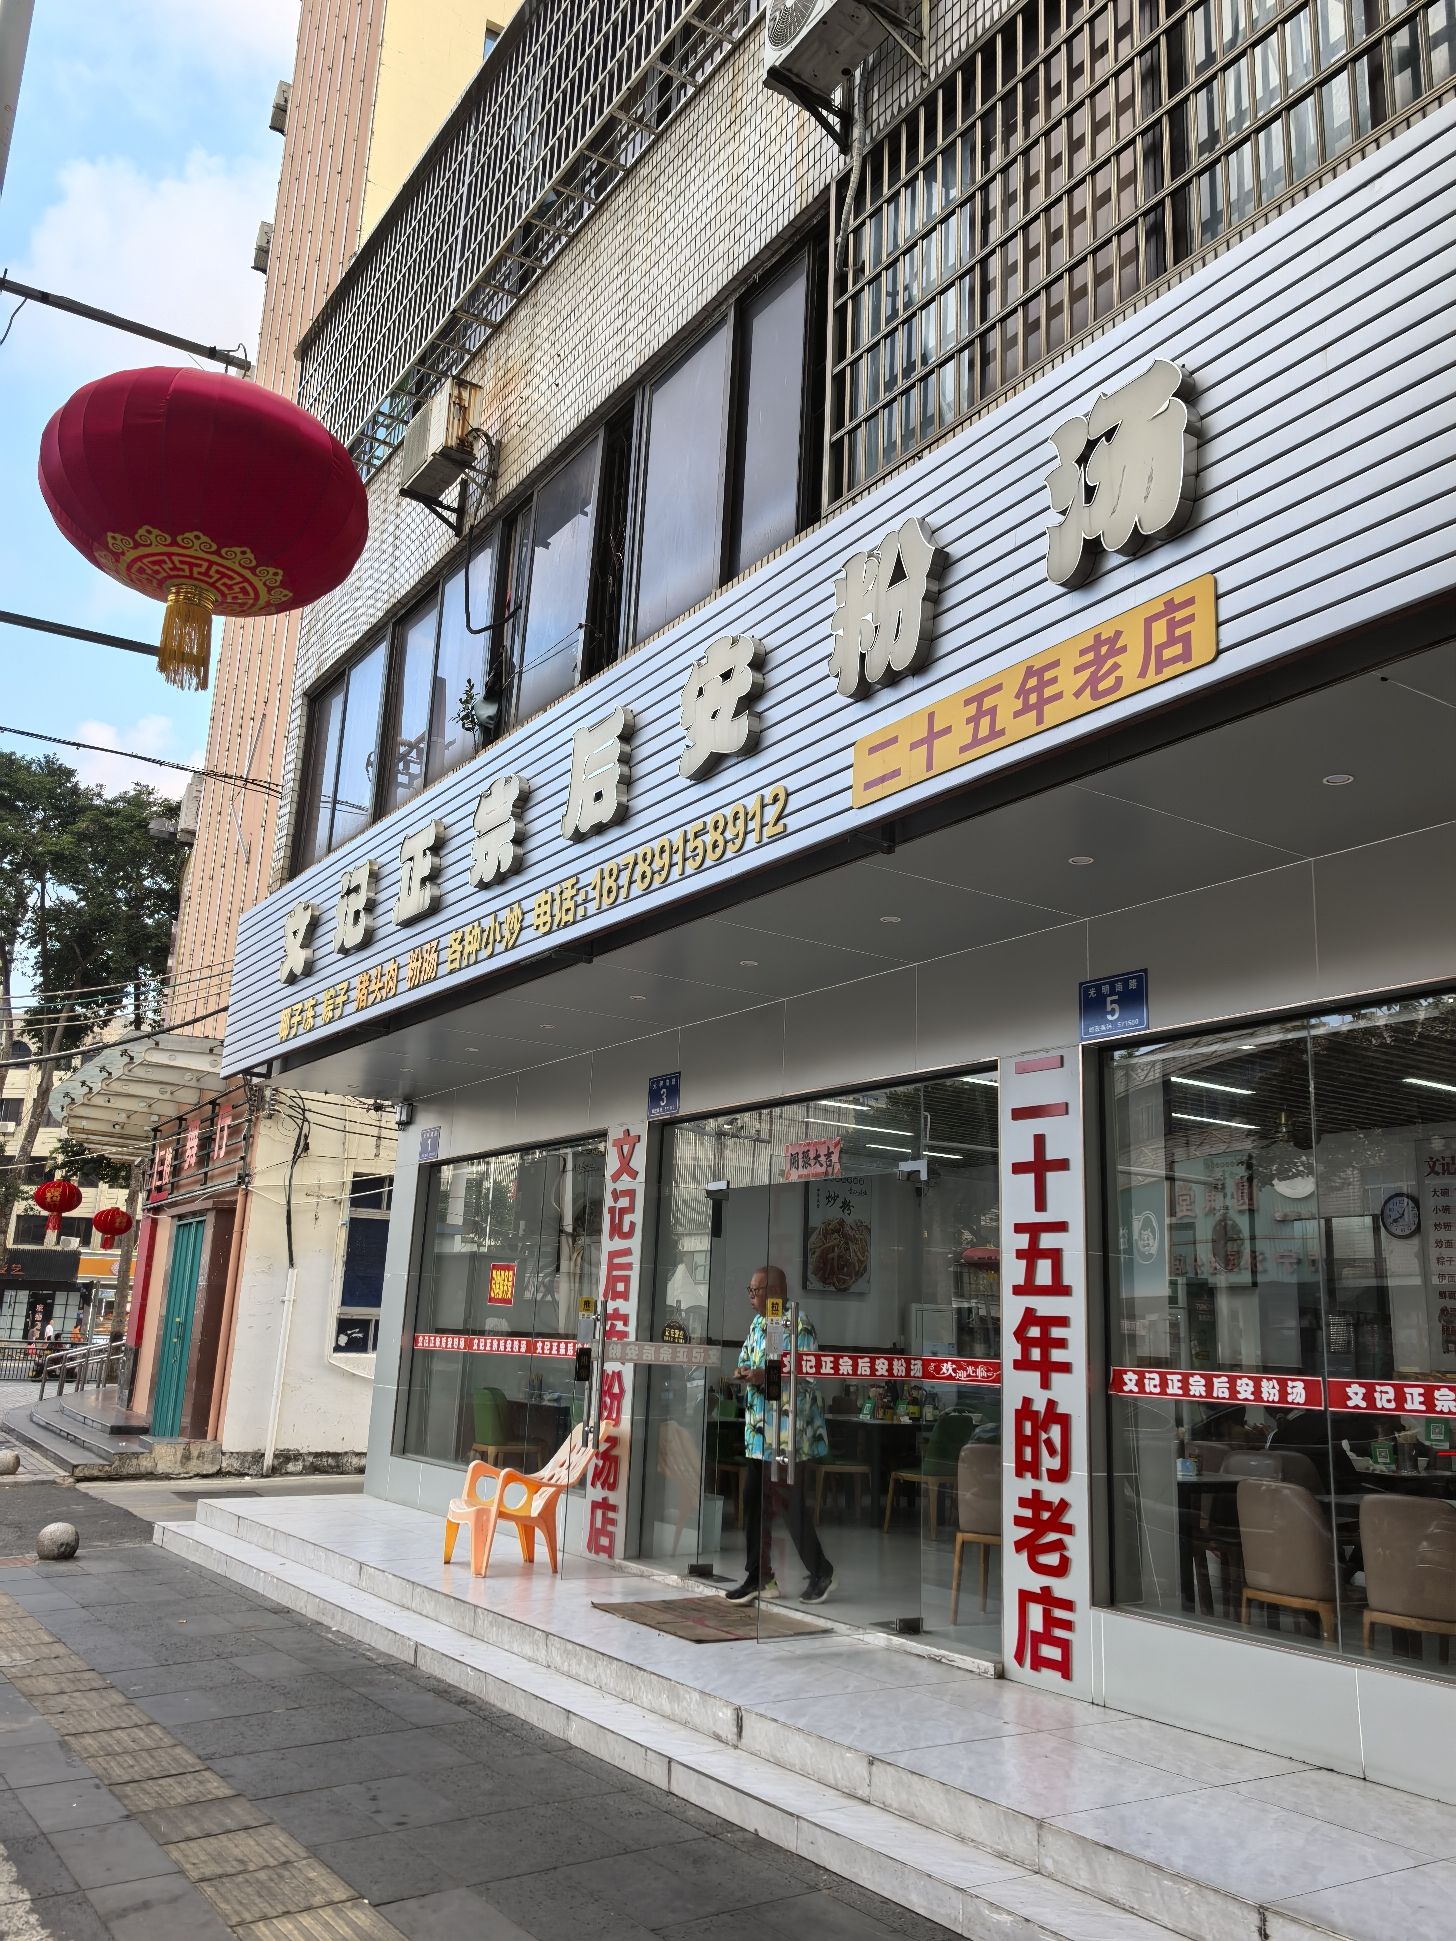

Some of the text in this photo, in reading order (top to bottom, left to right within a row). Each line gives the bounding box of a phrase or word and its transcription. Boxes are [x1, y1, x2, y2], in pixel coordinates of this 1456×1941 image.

[863, 595, 1197, 792] 二十五年老店
[278, 996, 318, 1041] 椰子冻
[321, 980, 351, 1024] 粽子
[354, 958, 400, 1011] 猪头肉
[406, 939, 441, 989] 粉肠
[447, 900, 525, 973] 各种小炒
[1106, 995, 1120, 1020] 5
[660, 1088, 667, 1106] 3
[1012, 1055, 1076, 1682] 二十五年的老店
[1122, 1371, 1456, 1413] 文记正宗后安粉汤 文记正宗
